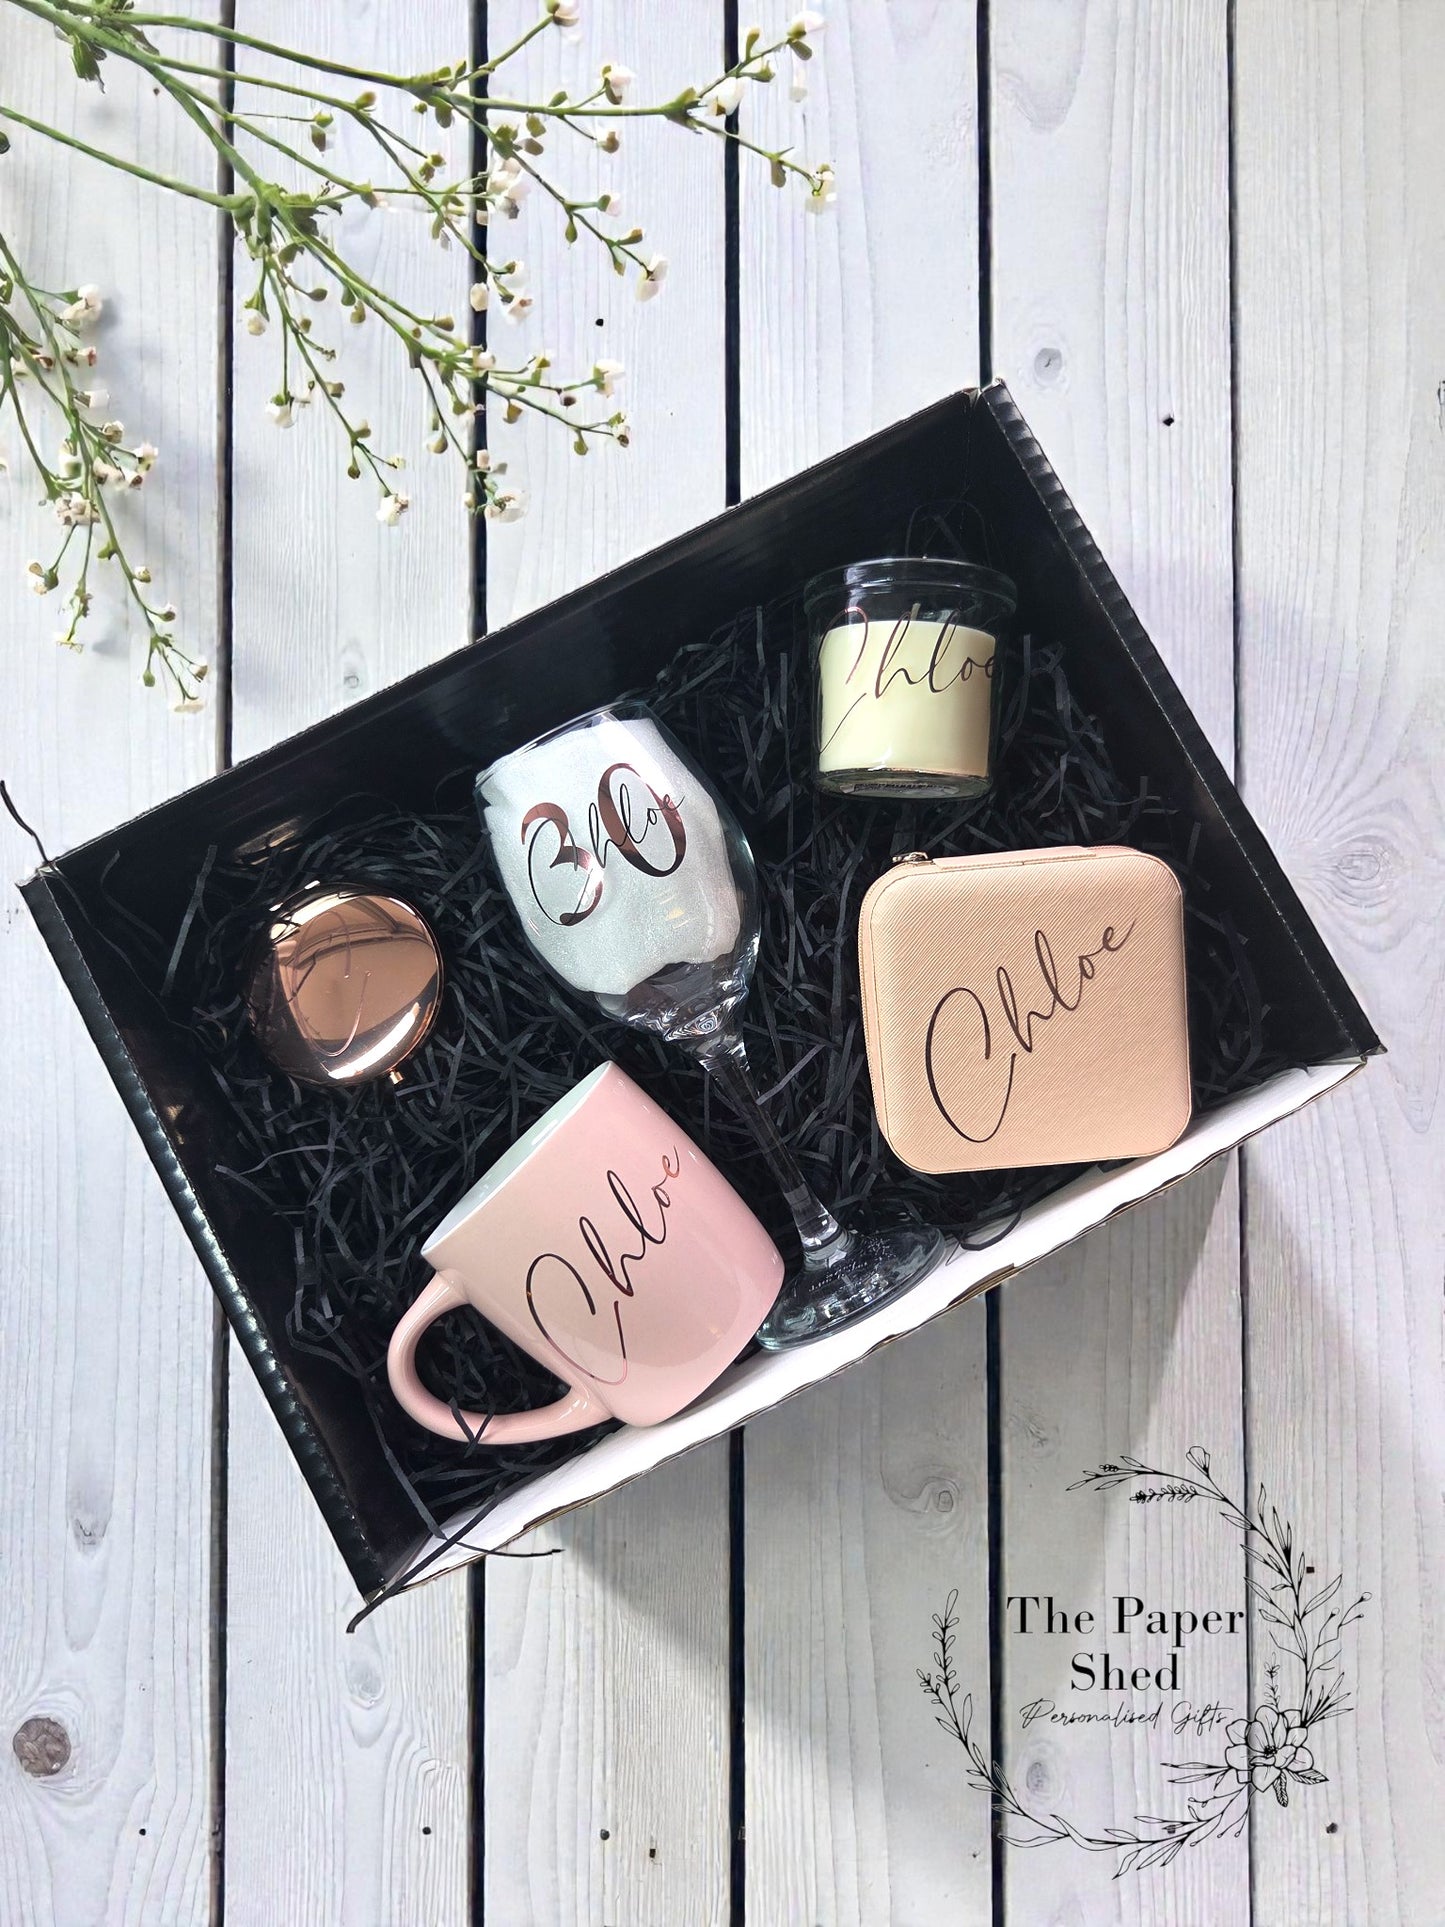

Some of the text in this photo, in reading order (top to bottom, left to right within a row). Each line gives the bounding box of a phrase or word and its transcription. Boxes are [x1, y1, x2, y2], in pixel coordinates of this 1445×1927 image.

[814, 606, 995, 755] Chloe
[521, 762, 687, 927] 30
[527, 783, 686, 926] Chloe
[925, 918, 1136, 1143] Chloe
[526, 1144, 680, 1386] Chloe
